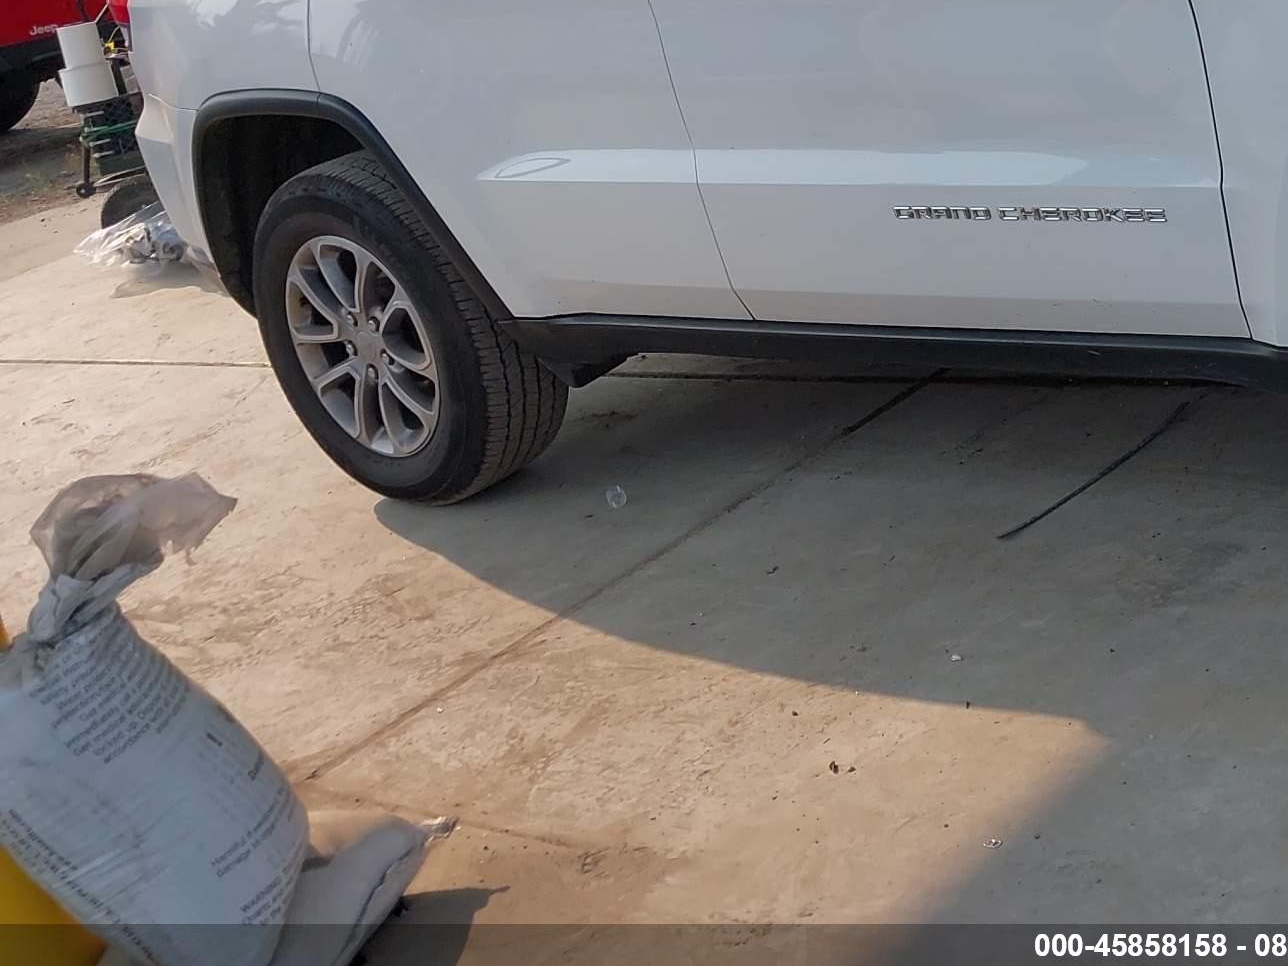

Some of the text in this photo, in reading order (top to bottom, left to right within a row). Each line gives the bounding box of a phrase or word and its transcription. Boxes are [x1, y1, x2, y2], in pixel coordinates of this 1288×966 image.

[29, 24, 58, 36] Jeep
[892, 205, 1168, 223] GRAND CHEROKEE
